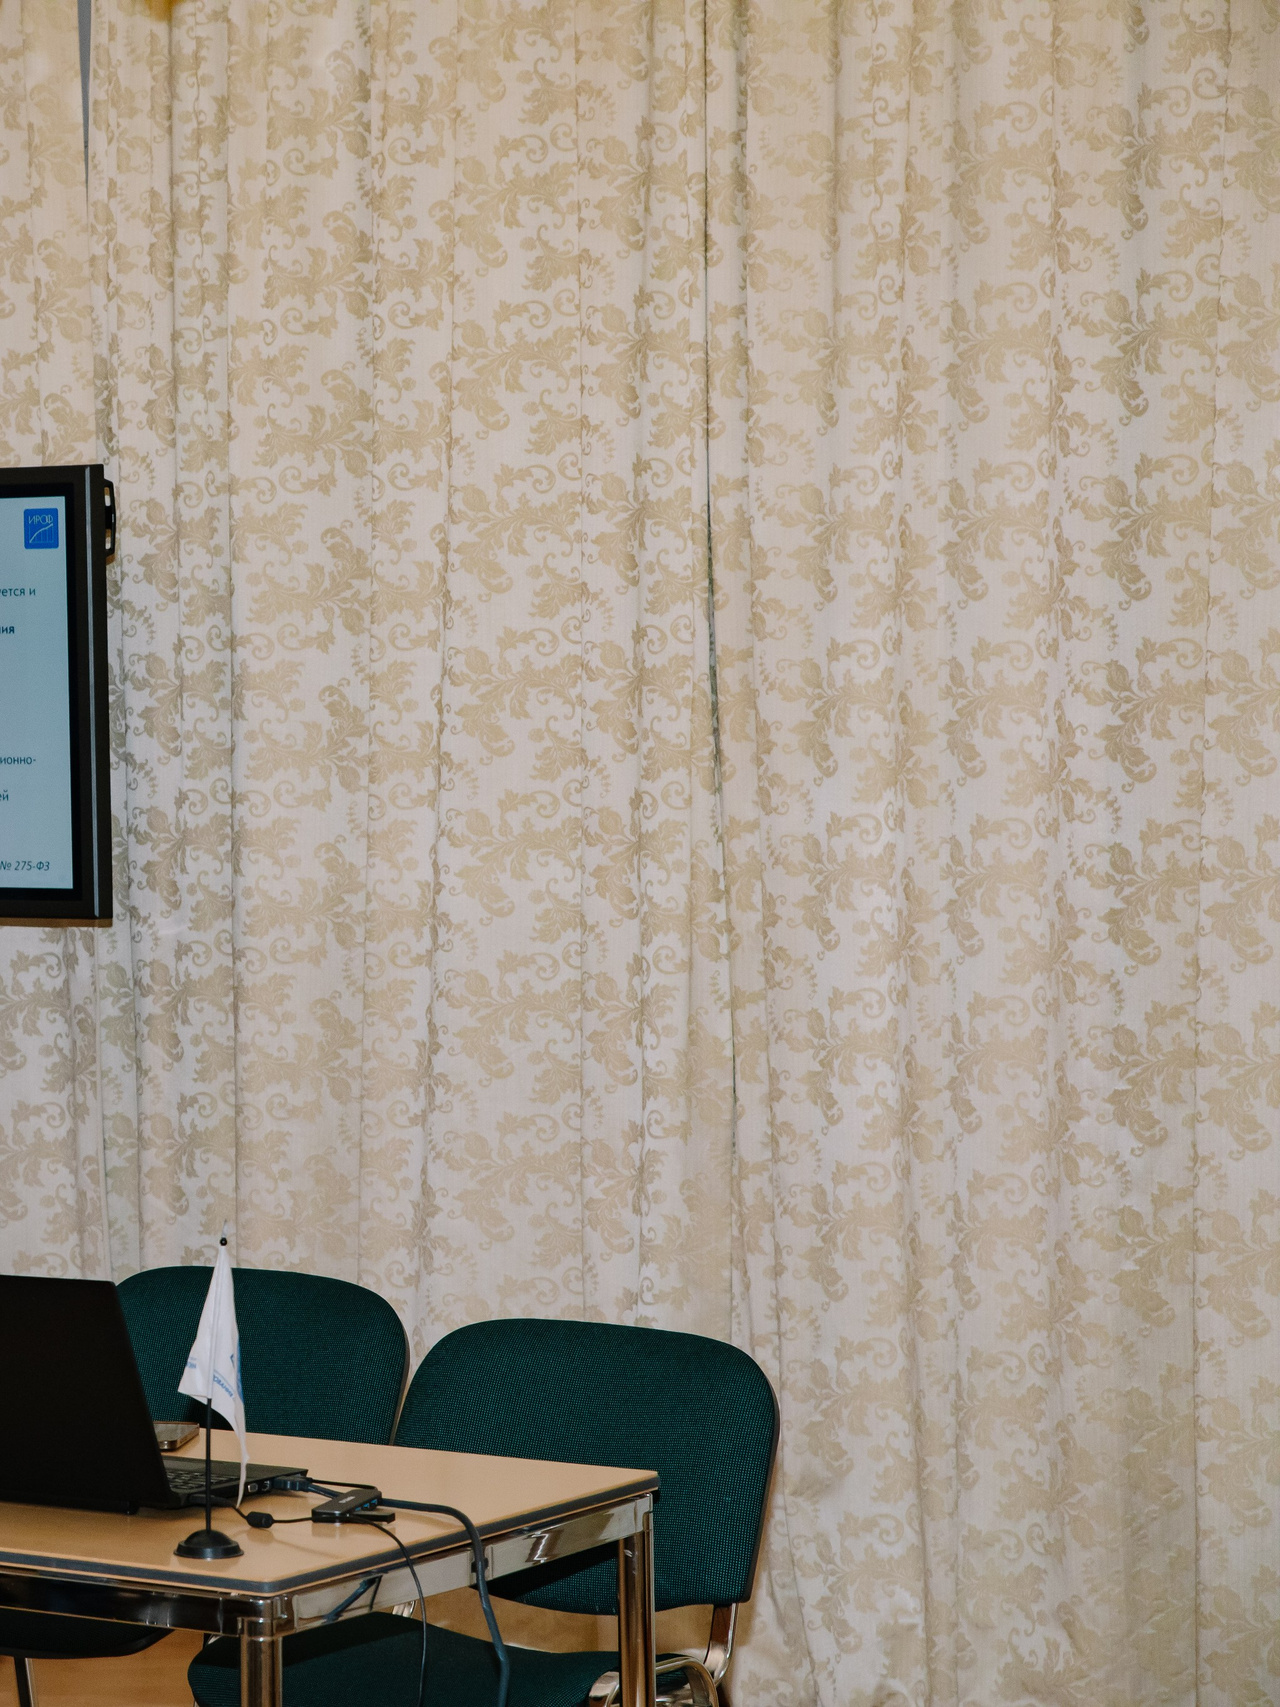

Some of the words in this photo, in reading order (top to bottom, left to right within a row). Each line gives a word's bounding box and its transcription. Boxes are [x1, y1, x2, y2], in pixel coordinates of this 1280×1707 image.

[29, 588, 36, 596] и
[0, 860, 12, 871] №
[14, 860, 51, 872] 275-ФЗ
